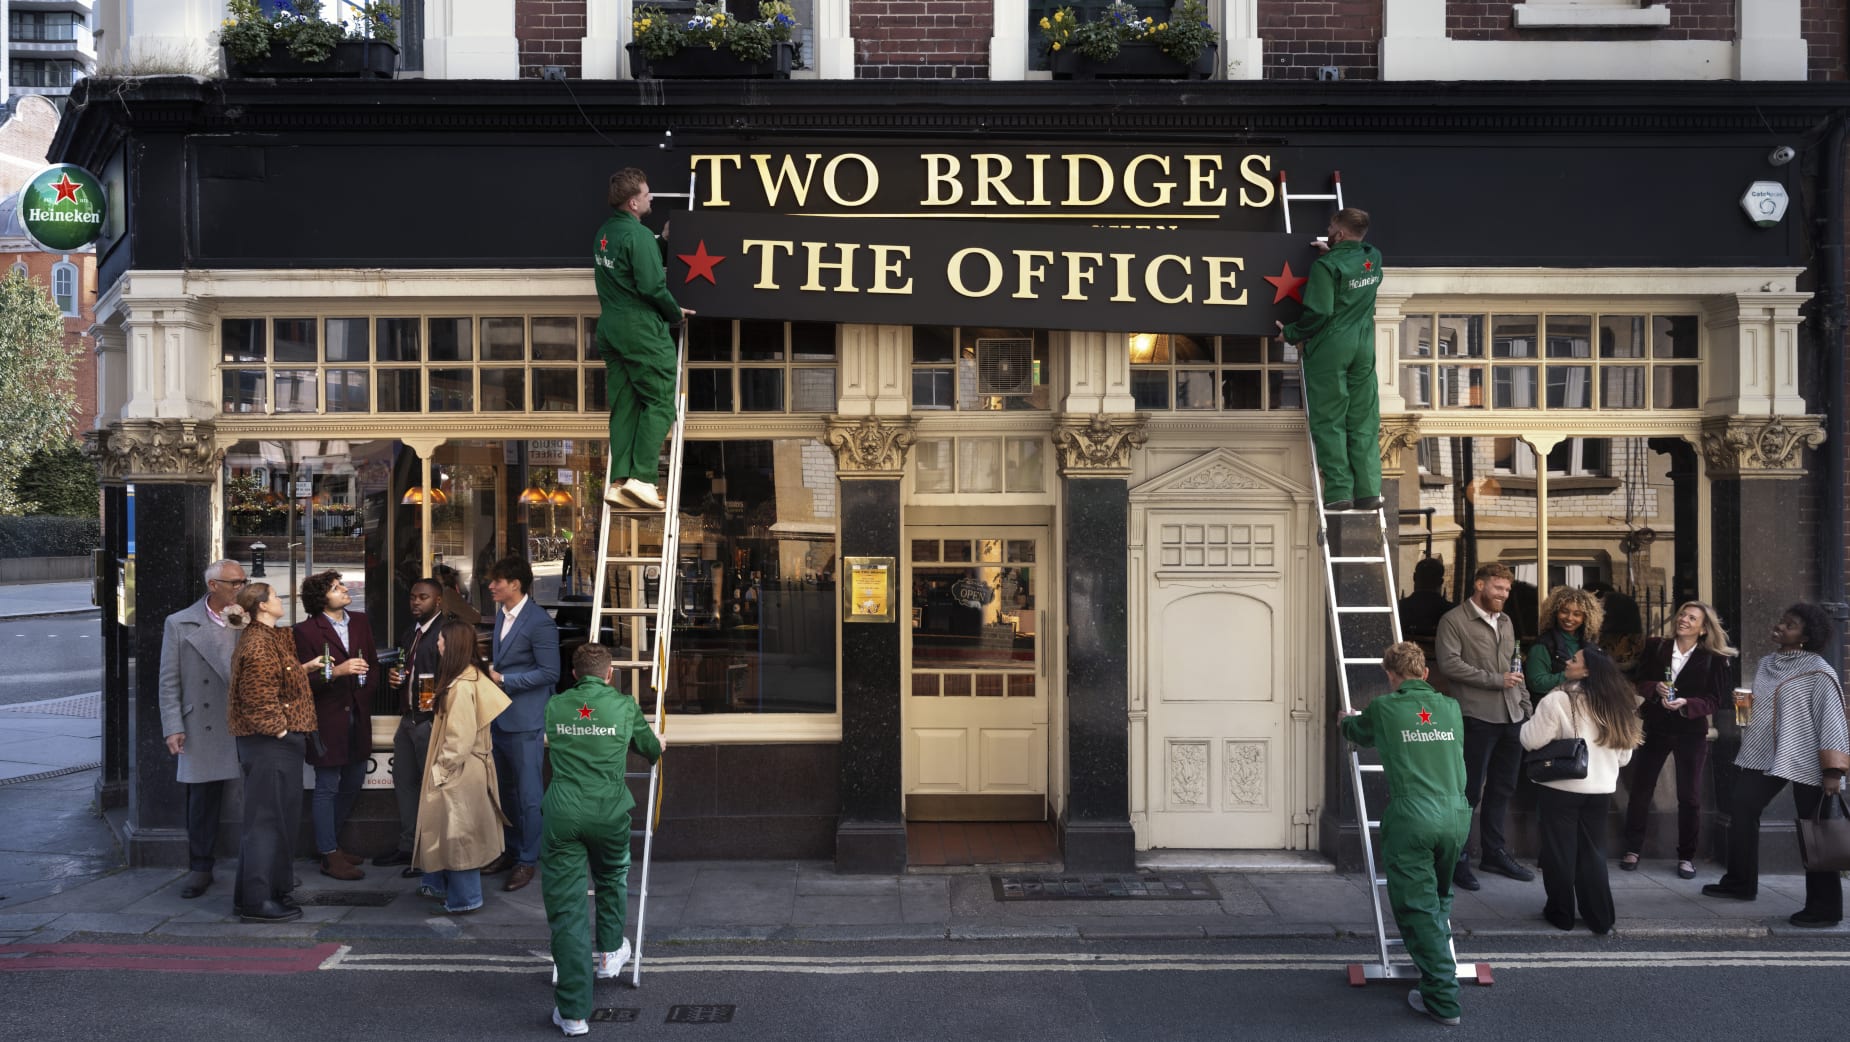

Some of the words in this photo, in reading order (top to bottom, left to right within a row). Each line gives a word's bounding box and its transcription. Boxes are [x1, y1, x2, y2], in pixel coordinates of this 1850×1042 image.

[691, 153, 880, 207] TWO
[920, 153, 1275, 208] BRIDGES
[29, 208, 100, 223] Heineken
[742, 239, 914, 294] THE
[946, 247, 1248, 305] OFFICE
[960, 589, 984, 601] OPEN
[556, 723, 617, 736] Heineken
[1401, 728, 1455, 742] Heineken
